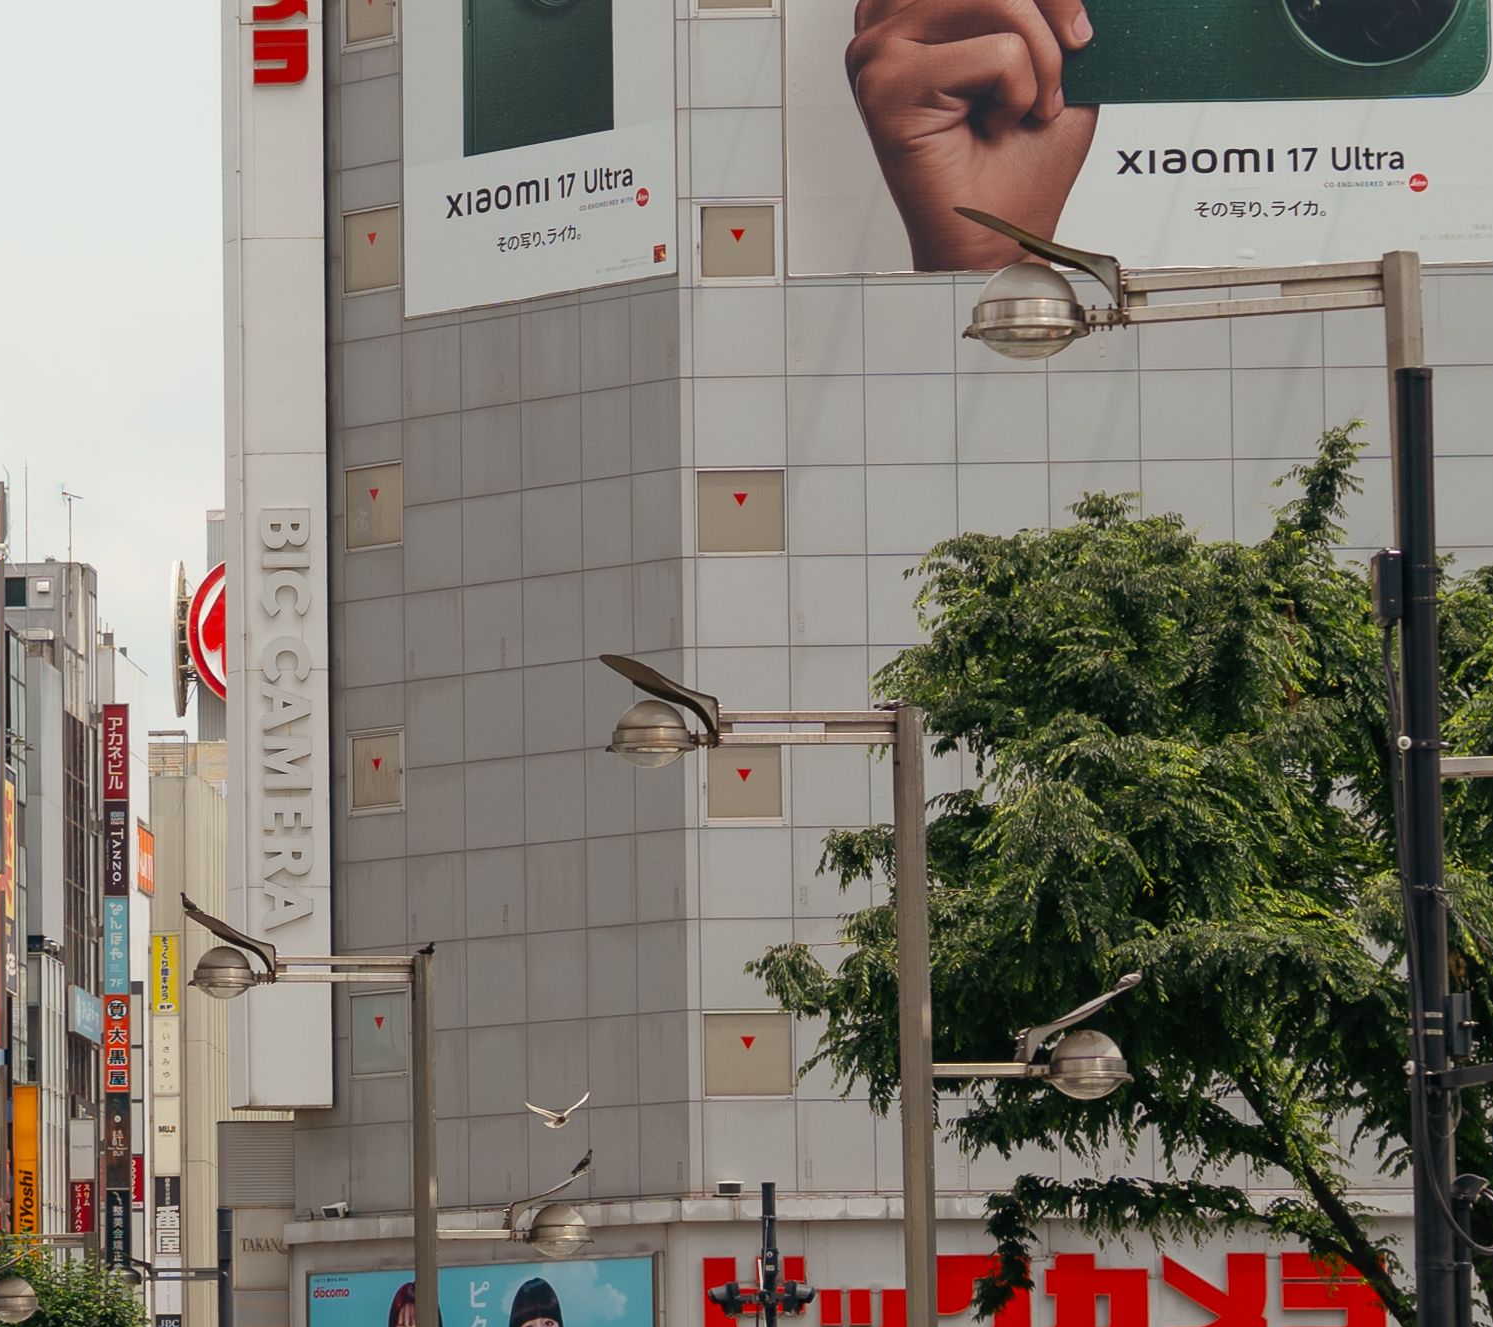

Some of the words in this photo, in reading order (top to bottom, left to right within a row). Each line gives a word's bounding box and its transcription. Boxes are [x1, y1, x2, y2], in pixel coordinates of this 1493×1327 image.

[1116, 148, 1274, 174] xiaomi
[1287, 148, 1318, 172] 17
[1331, 146, 1404, 171] Ultra
[446, 178, 549, 219] xiaomi
[558, 173, 576, 198] 17
[584, 168, 633, 193] Ultra
[1194, 200, 1327, 219] その写り、ライカ。
[497, 225, 582, 255] その写り、ライカ。
[260, 508, 311, 617] BIC
[107, 716, 125, 791] アカネビル
[261, 635, 315, 932] CAMERA
[109, 903, 124, 961] なんぼや
[110, 978, 124, 988] 7F
[109, 1002, 125, 1018] 質
[107, 1026, 128, 1088] 大黒屋
[158, 1125, 177, 1133] MUJI
[313, 1285, 351, 1300] docomo
